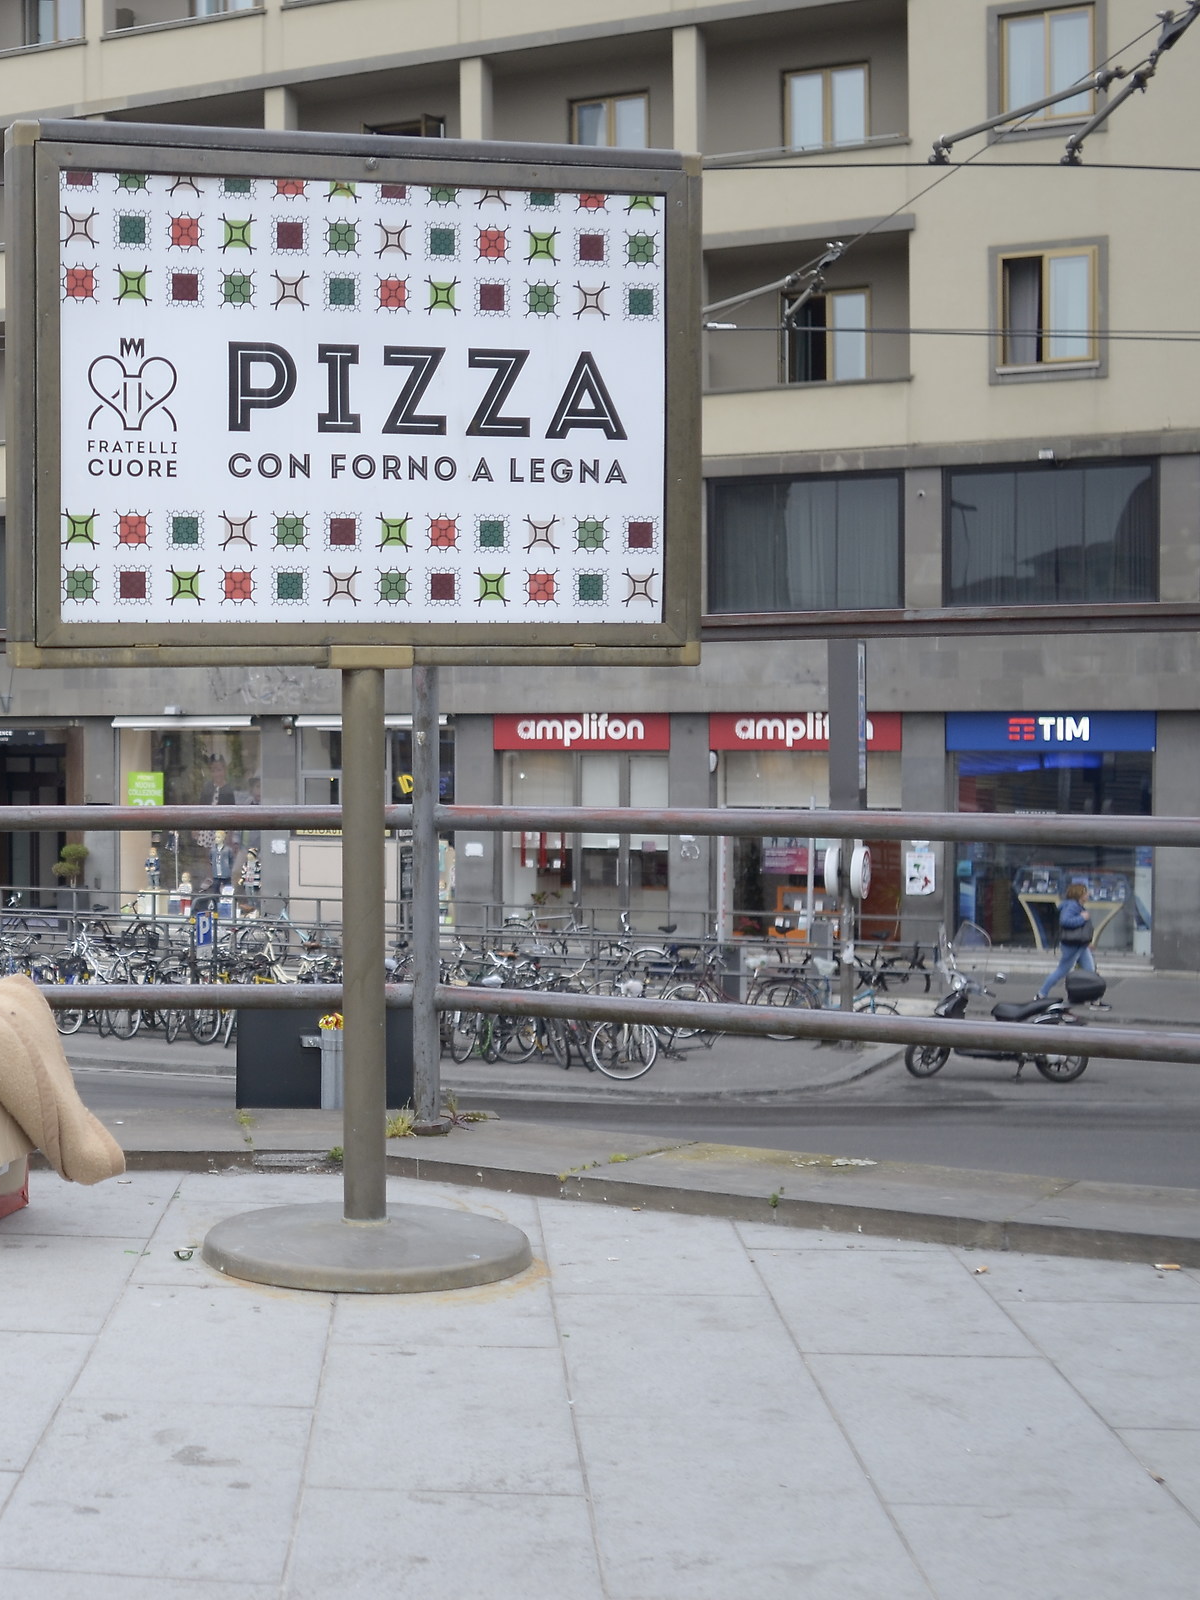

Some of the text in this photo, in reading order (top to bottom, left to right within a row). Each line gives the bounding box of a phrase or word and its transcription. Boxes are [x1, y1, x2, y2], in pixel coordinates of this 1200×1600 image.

[228, 341, 628, 441] PIZZA
[87, 439, 177, 455] FRATELLI
[87, 458, 177, 478] CUORE
[228, 452, 628, 484] CON FORNO A LEGNA
[517, 713, 645, 747] amplifon
[1038, 716, 1090, 741] TIM
[199, 916, 211, 944] P
